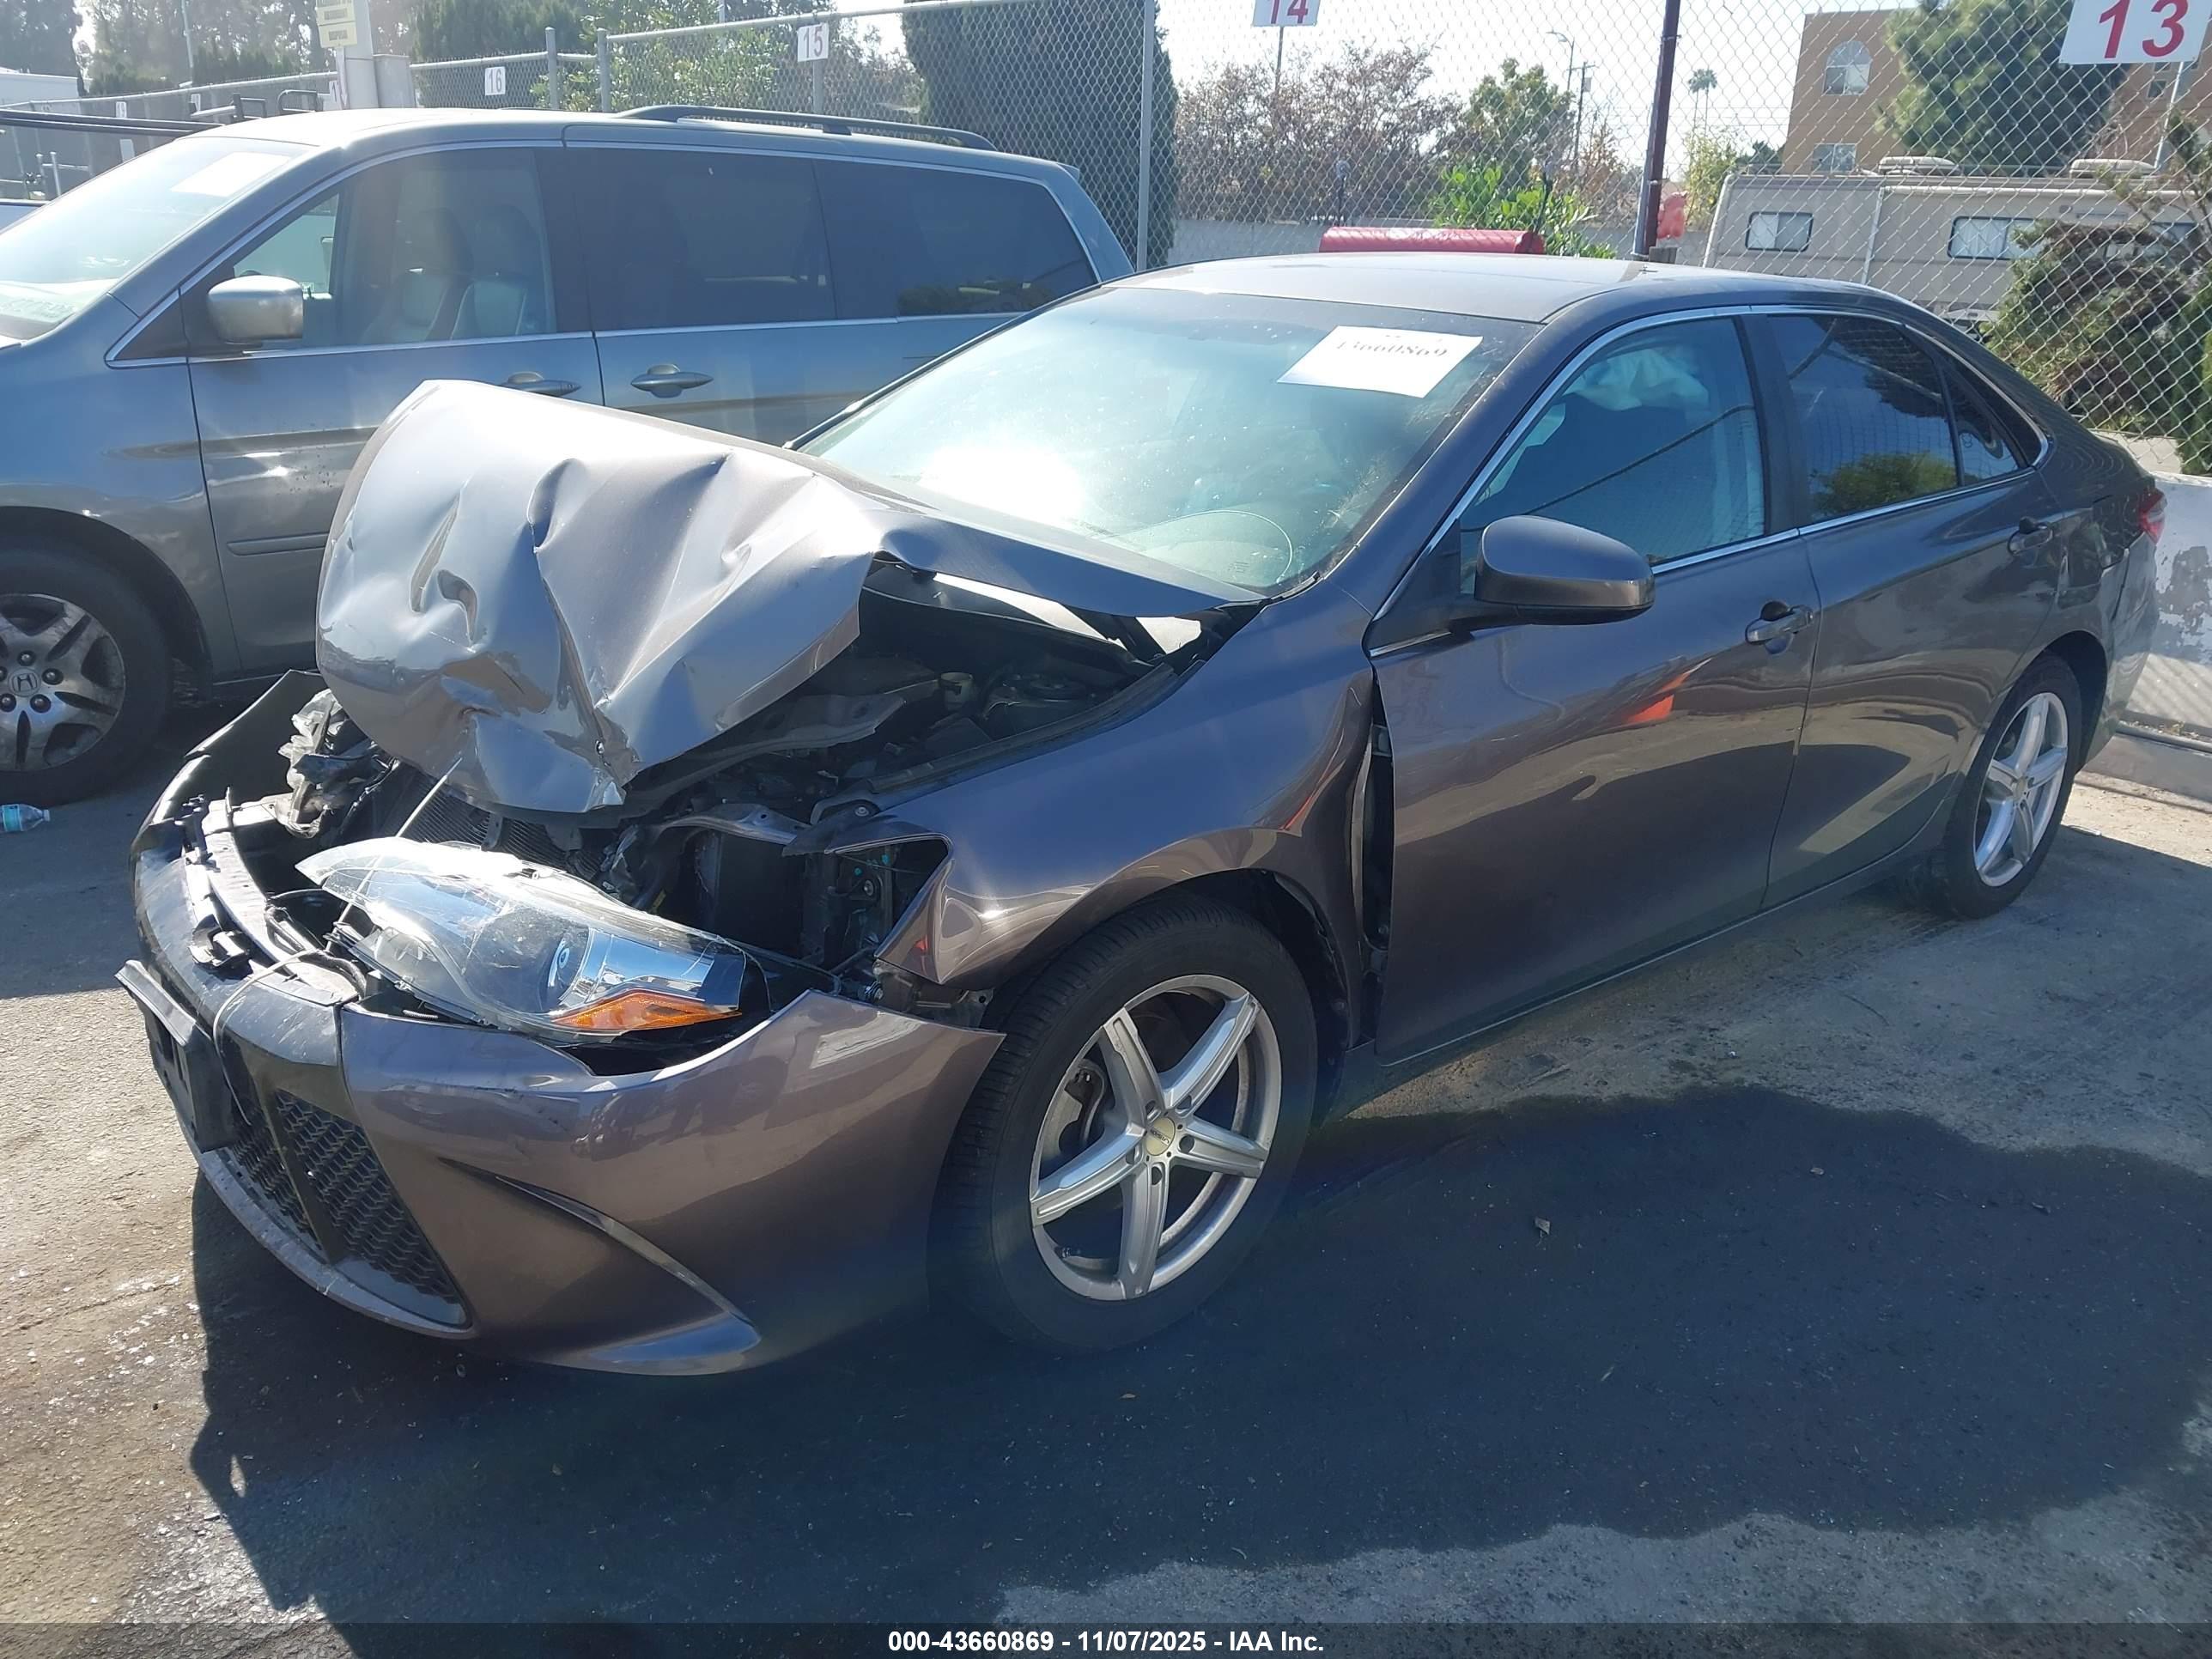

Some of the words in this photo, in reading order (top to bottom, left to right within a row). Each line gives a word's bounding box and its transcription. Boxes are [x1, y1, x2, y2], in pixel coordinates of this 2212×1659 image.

[1269, 0, 1309, 24] 14
[803, 26, 823, 58] 15
[2099, 0, 2189, 58] 13
[489, 69, 502, 93] 16
